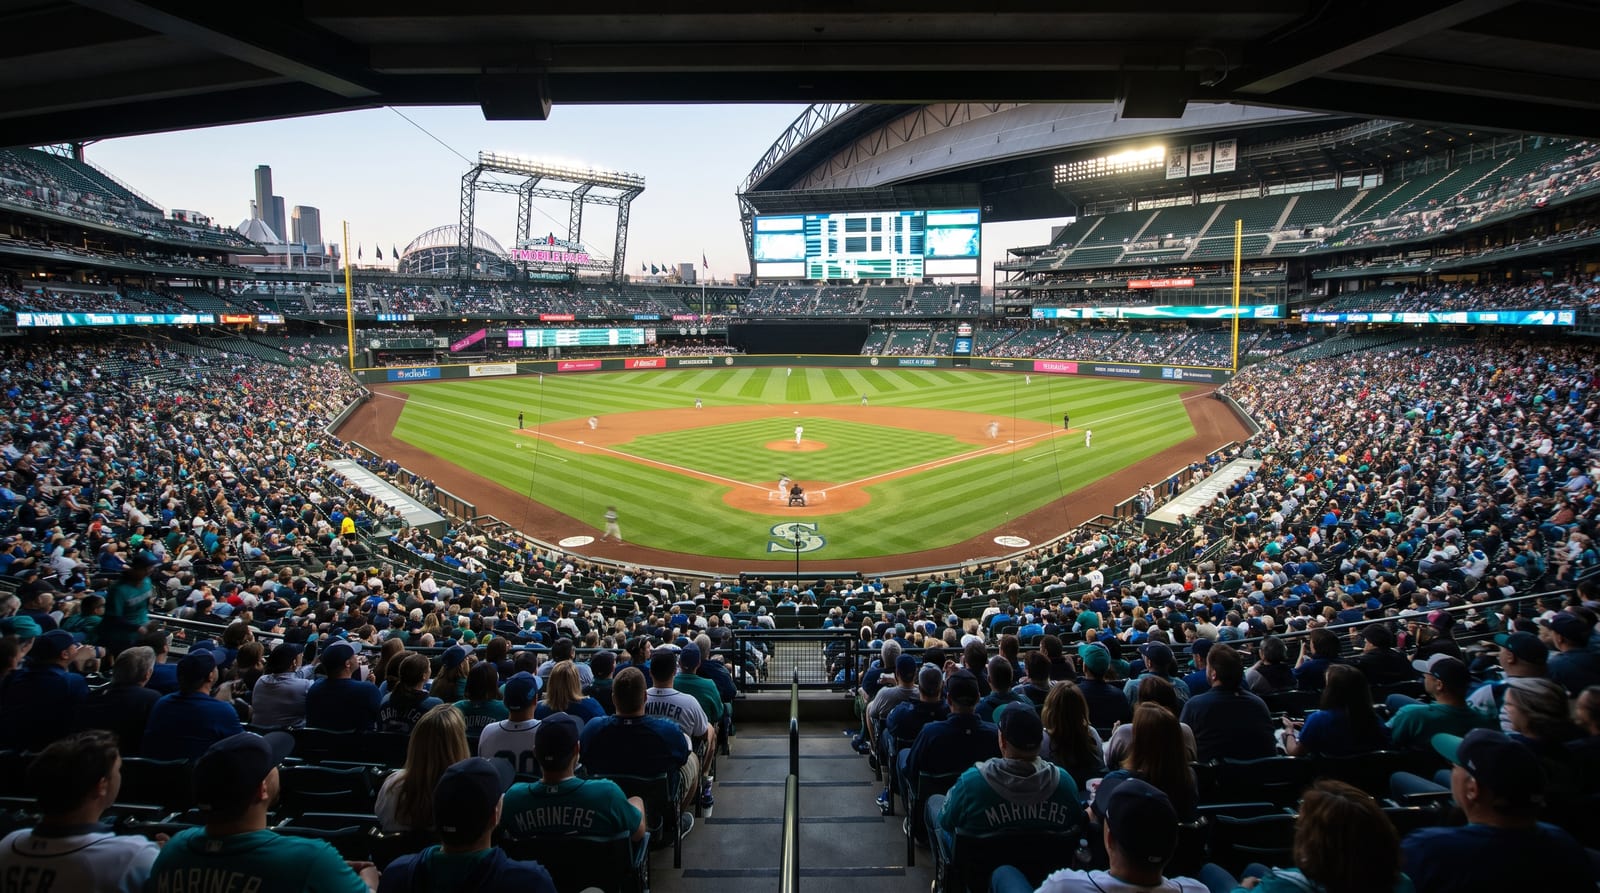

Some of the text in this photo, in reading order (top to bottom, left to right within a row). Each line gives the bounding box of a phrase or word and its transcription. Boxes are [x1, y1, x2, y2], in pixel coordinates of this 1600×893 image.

[521, 250, 560, 263] MOBILE
[562, 252, 590, 264] PARK
[514, 805, 595, 832] MARINERS
[984, 801, 1068, 827] MARINERS
